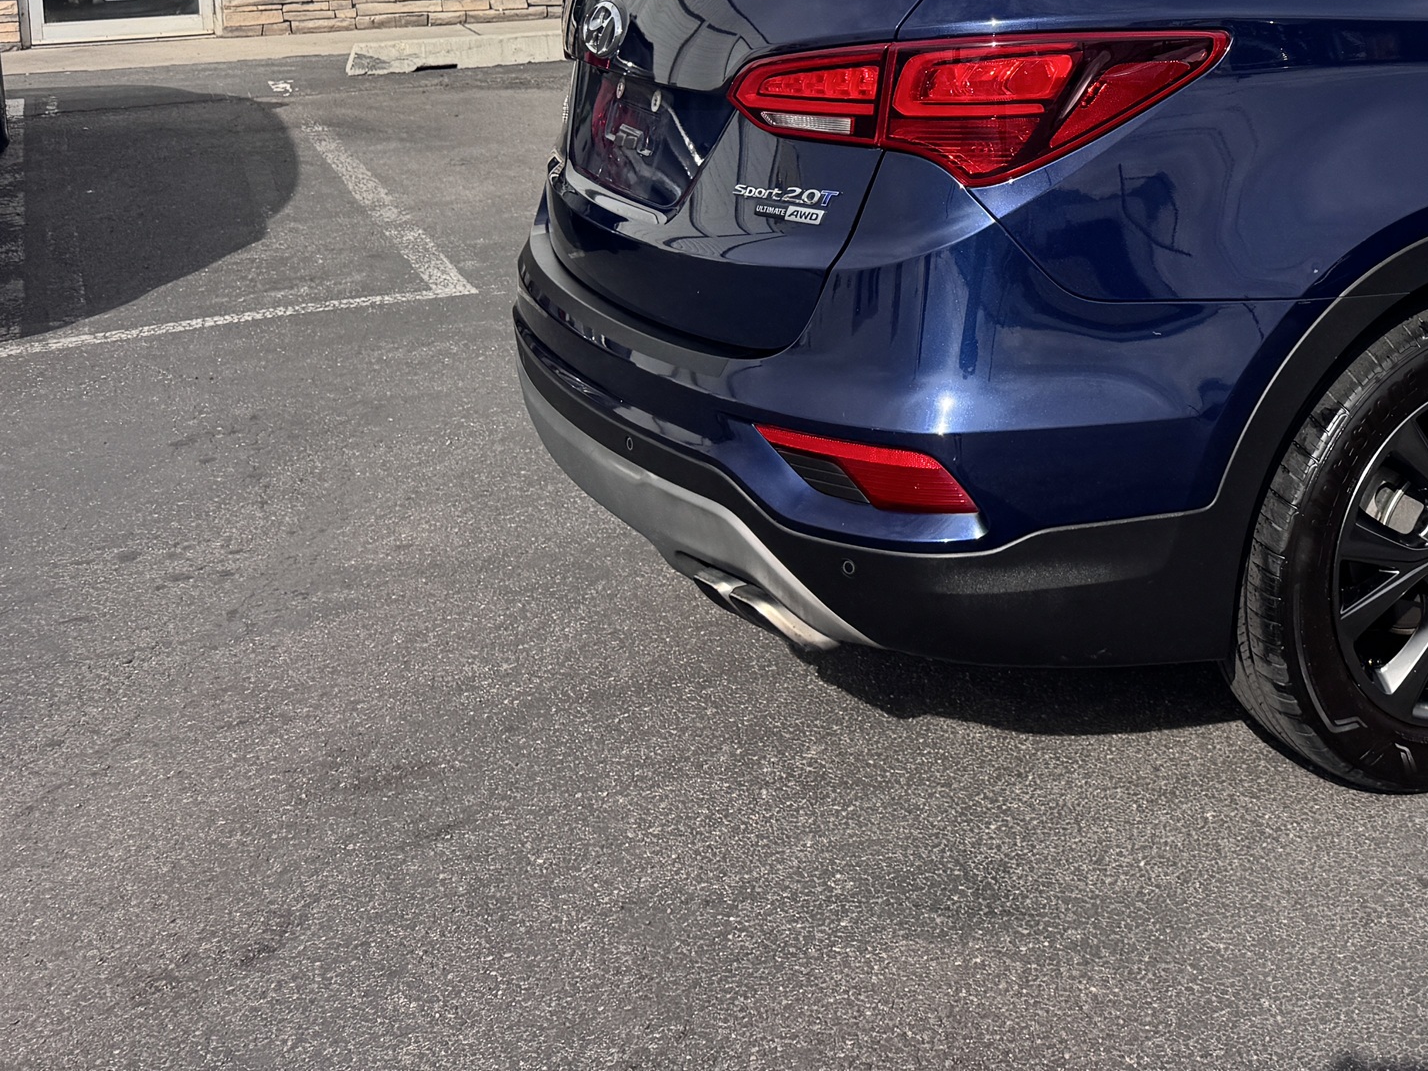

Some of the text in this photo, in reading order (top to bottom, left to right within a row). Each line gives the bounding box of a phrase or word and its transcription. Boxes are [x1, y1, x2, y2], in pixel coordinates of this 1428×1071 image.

[732, 184, 782, 200] Sport
[756, 204, 819, 221] ULTIMATE AWD
